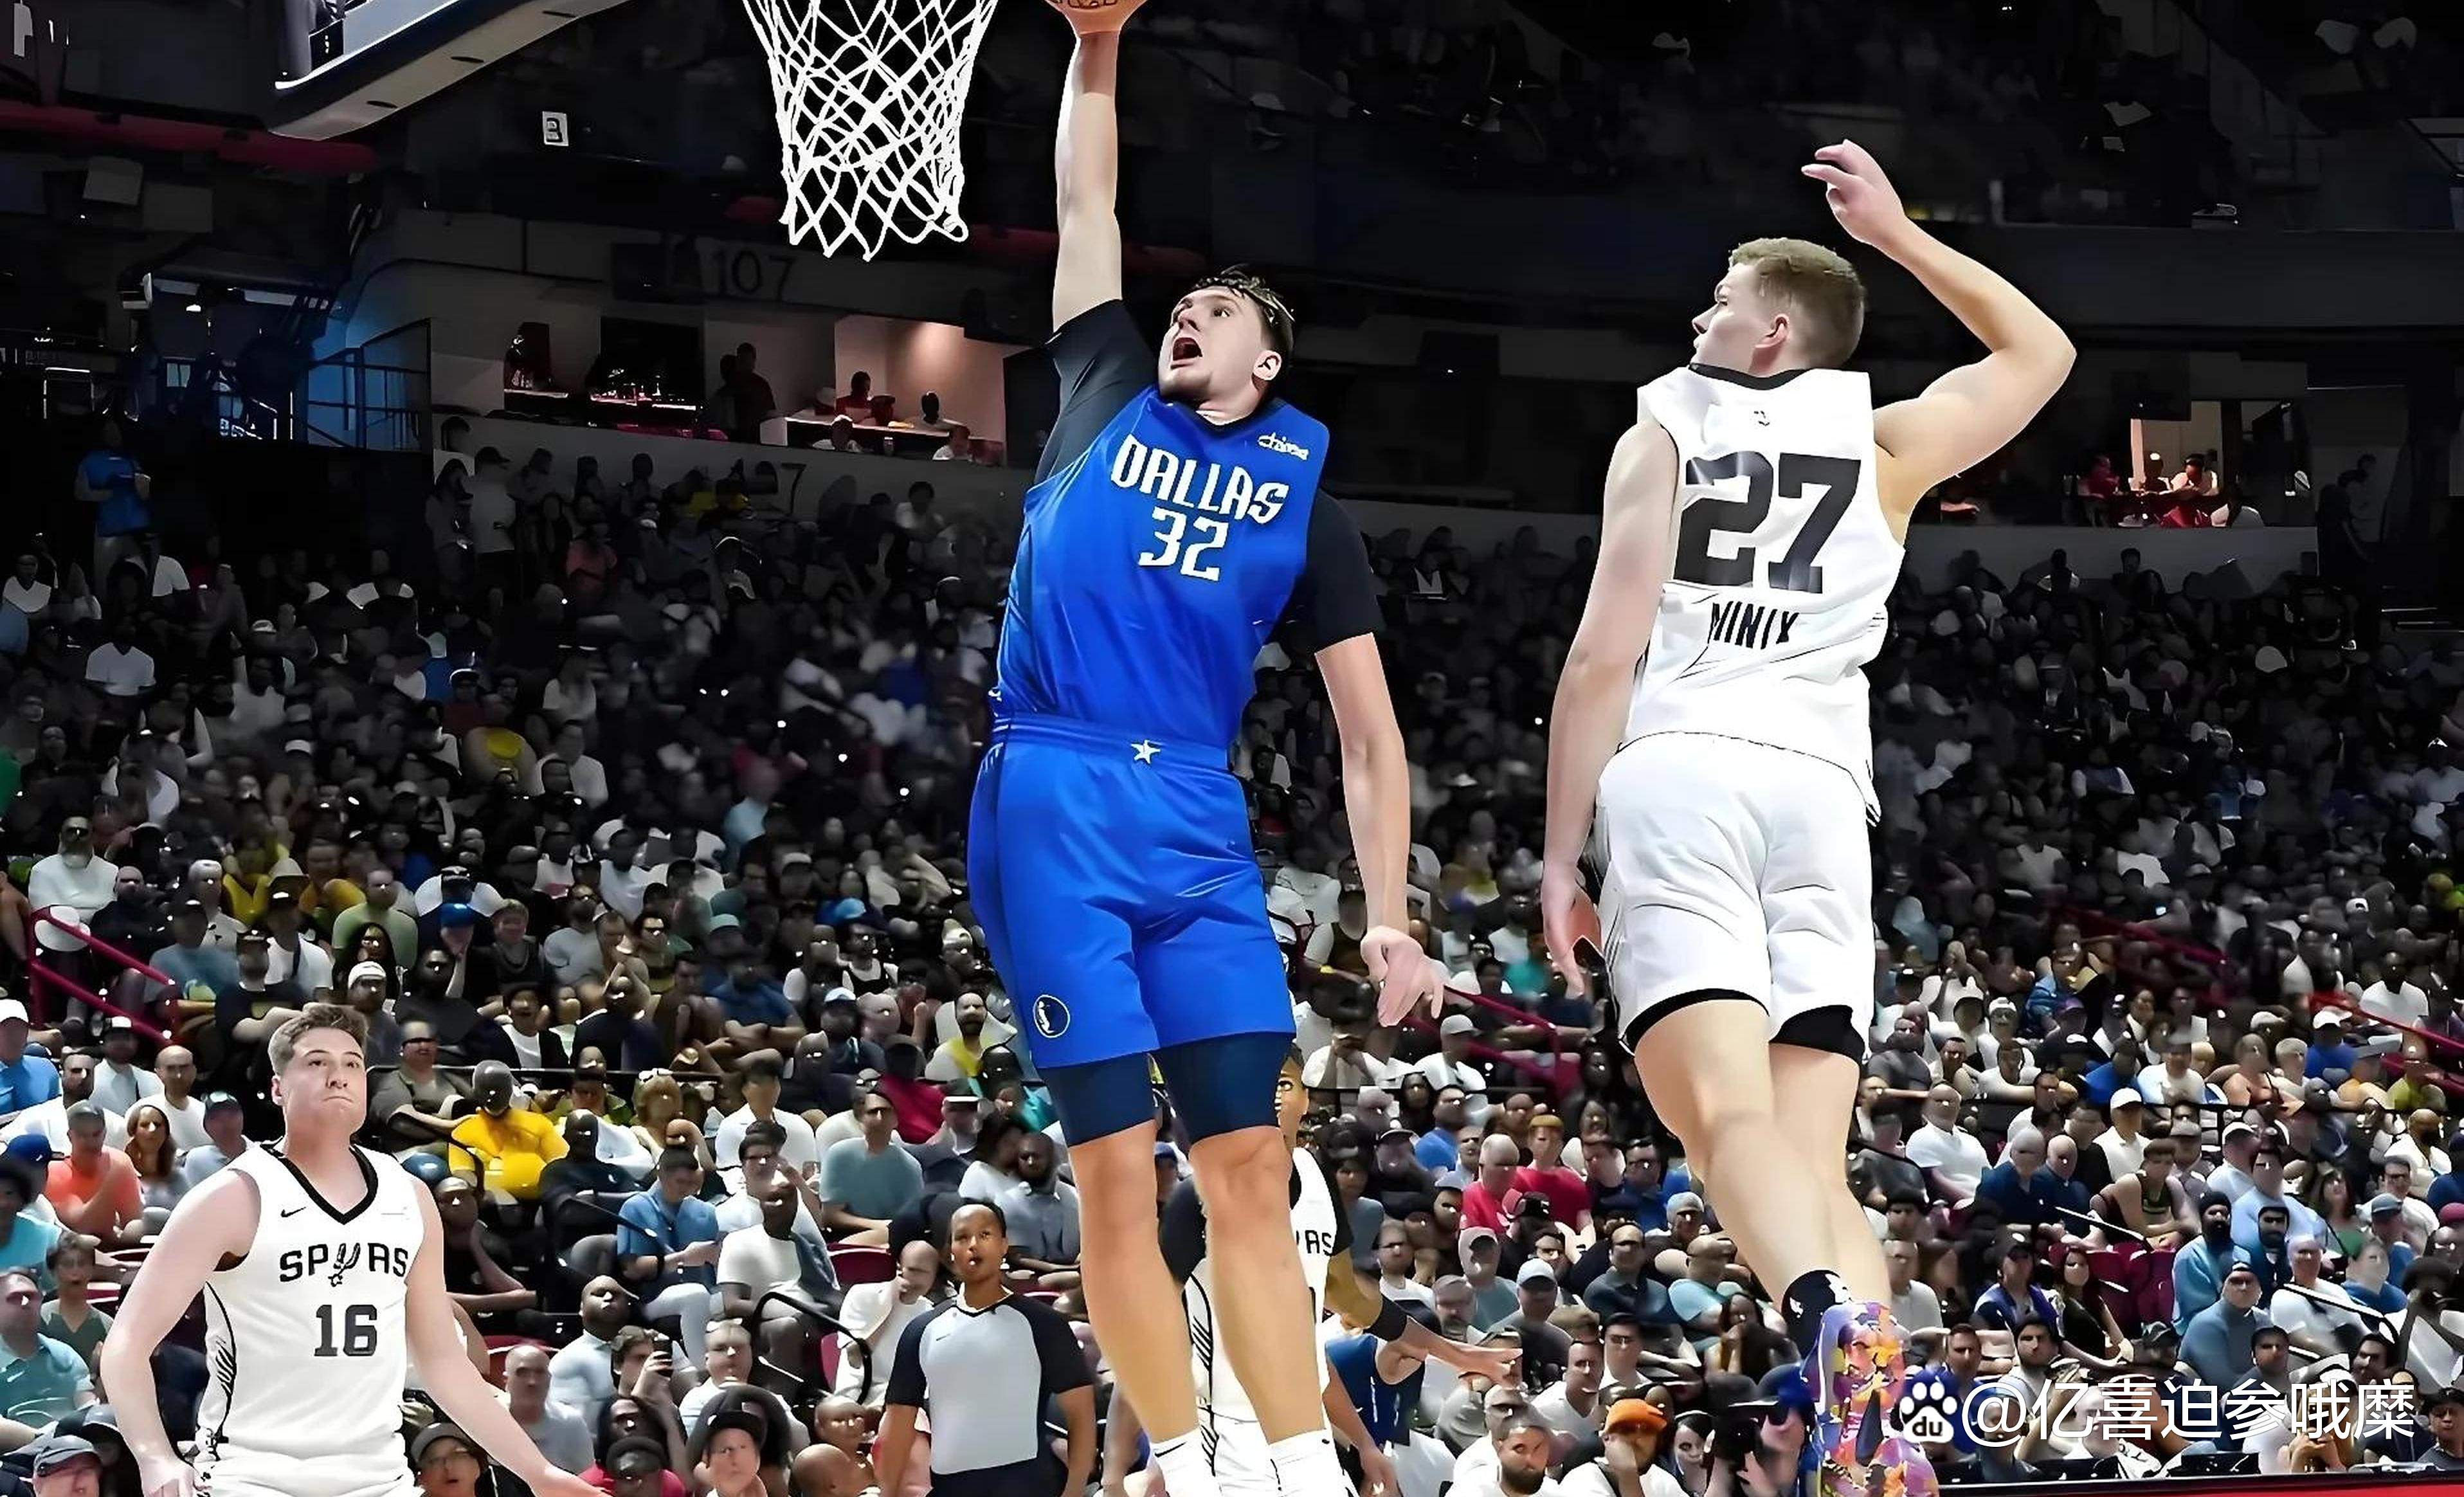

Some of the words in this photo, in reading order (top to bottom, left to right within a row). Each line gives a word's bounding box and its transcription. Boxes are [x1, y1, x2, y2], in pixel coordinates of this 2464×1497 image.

[1110, 433, 1289, 524] DALLAS
[1138, 506, 1228, 581] 32
[1673, 450, 1861, 594] 27
[280, 1242, 409, 1287] SPURS
[314, 1304, 377, 1357] 16
